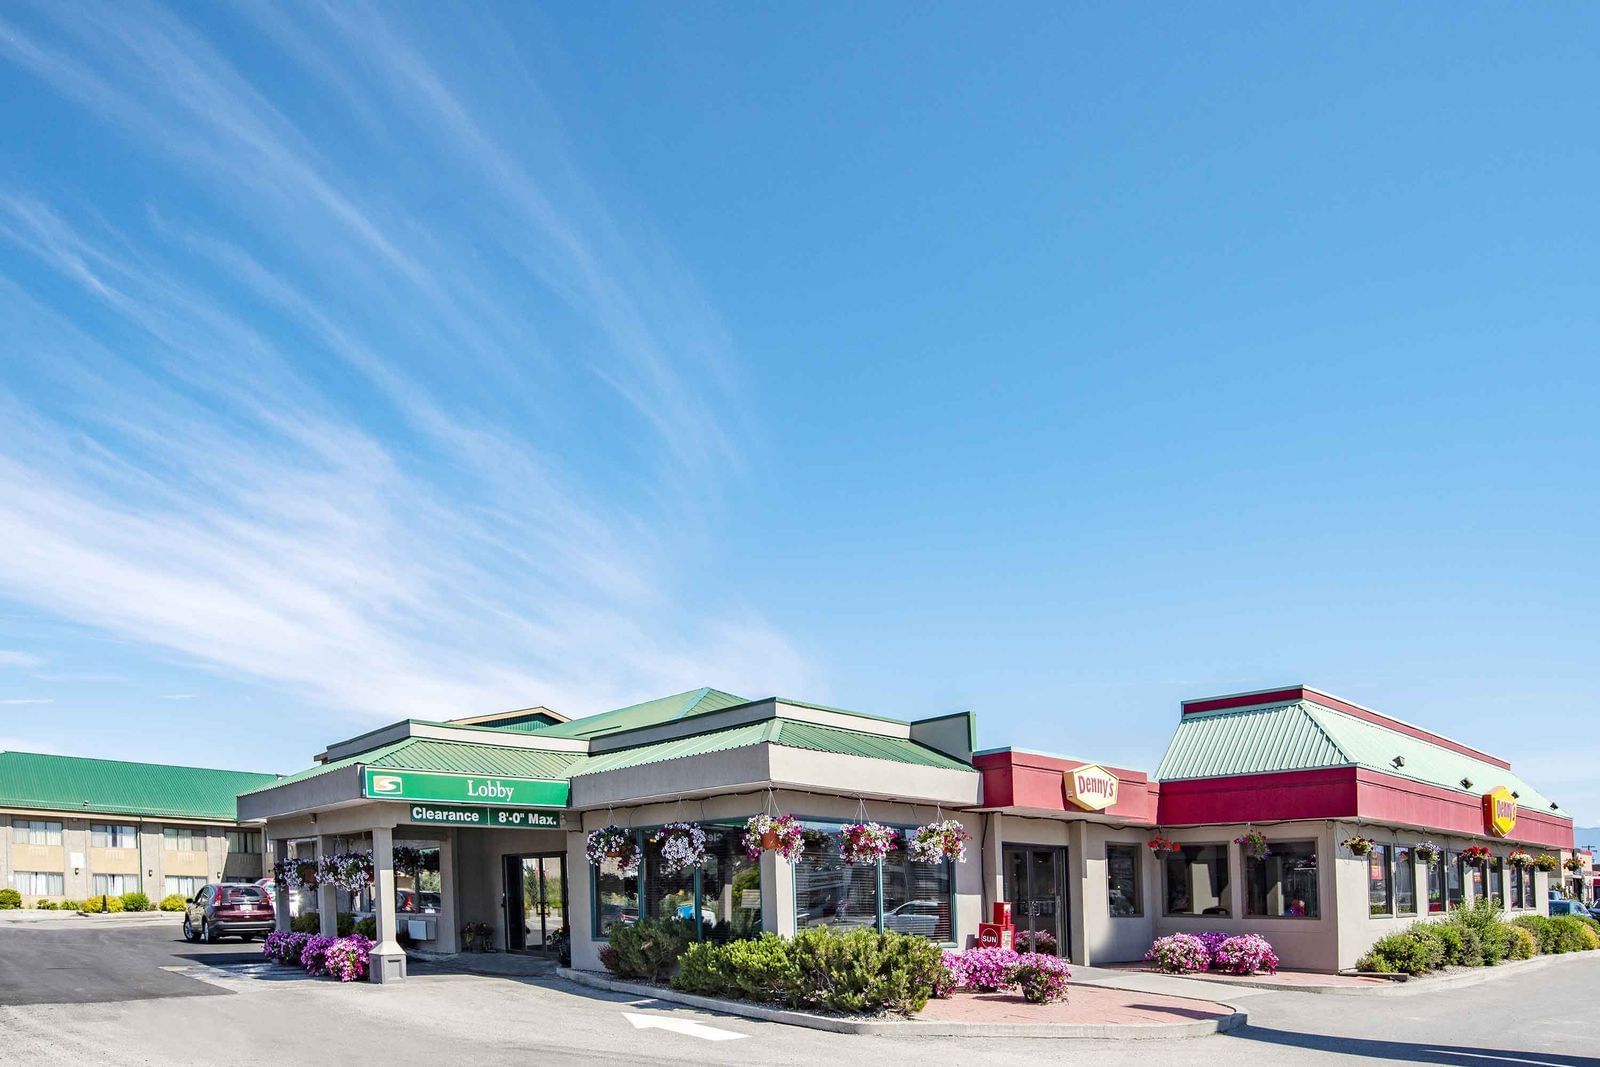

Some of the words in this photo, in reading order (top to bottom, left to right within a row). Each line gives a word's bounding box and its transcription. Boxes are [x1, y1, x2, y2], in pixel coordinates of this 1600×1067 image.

[467, 780, 514, 801] Lobby
[1077, 775, 1114, 798] Denny's
[412, 807, 480, 821] Clearance
[528, 813, 557, 825] Max.
[982, 935, 997, 943] SUN
